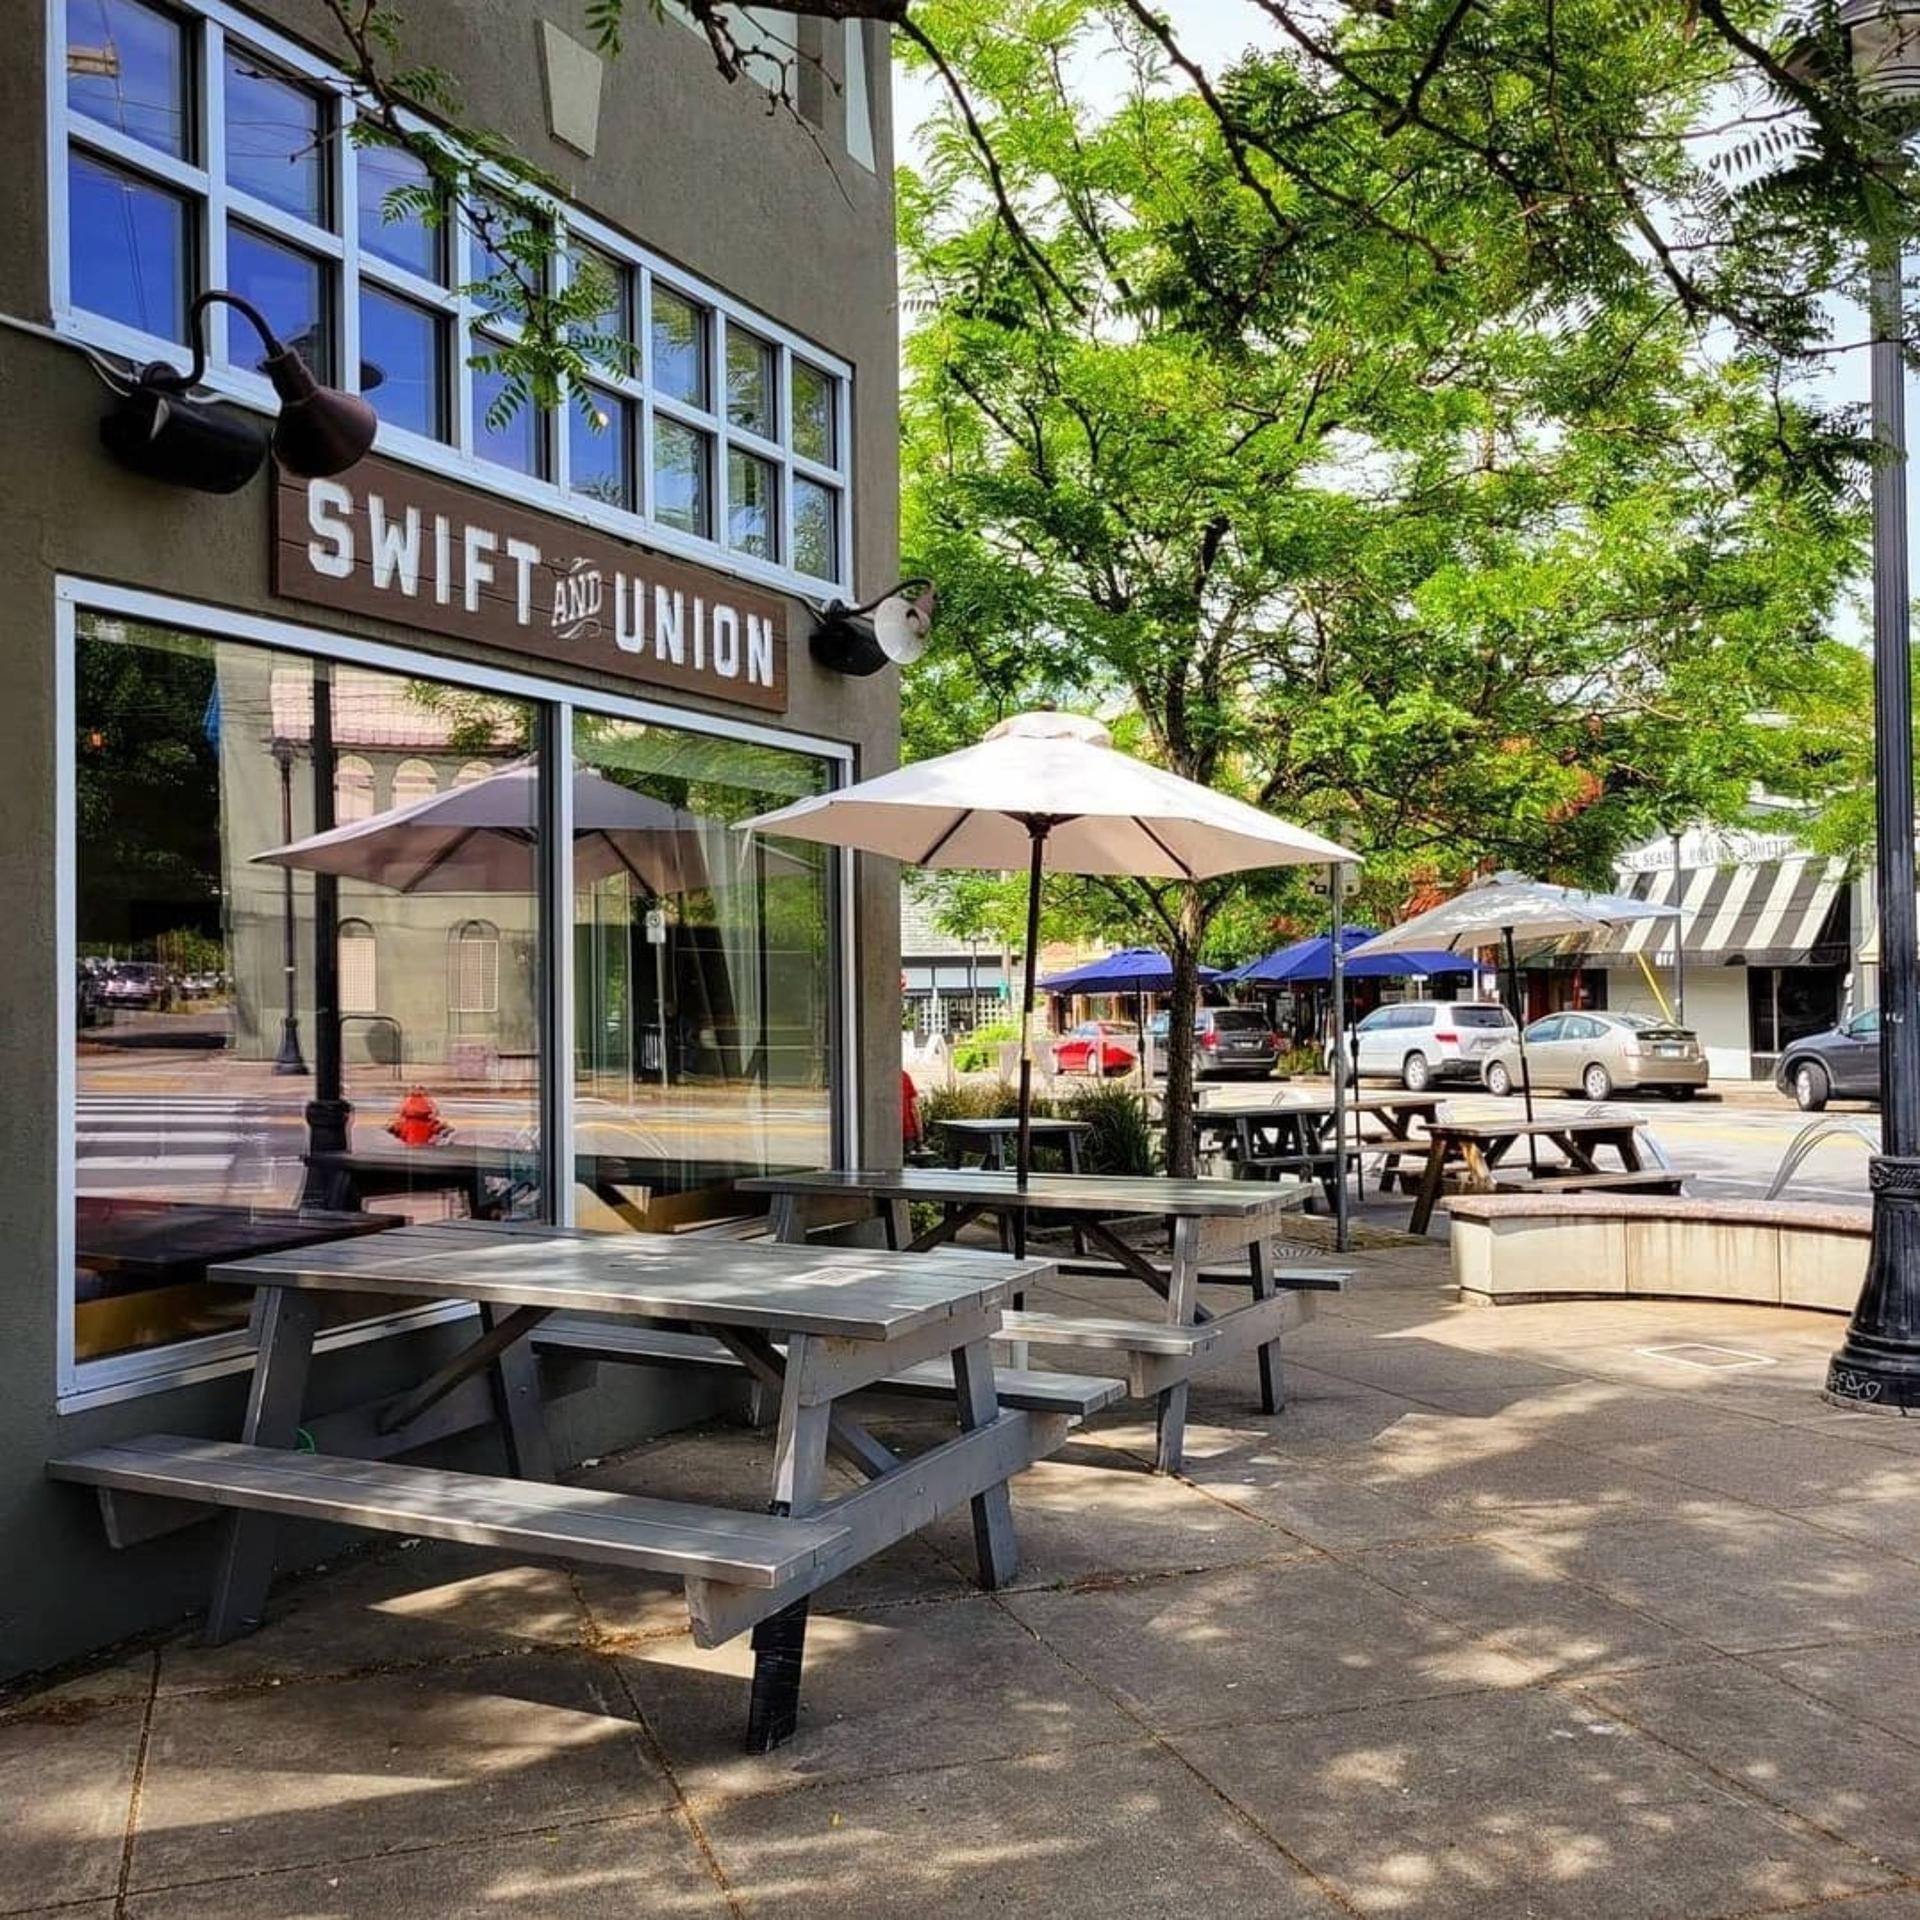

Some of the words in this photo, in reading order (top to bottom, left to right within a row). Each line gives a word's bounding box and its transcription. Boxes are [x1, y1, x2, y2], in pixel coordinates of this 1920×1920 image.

[307, 477, 541, 625] SWIFT
[551, 570, 602, 627] AND
[614, 571, 774, 688] UNION
